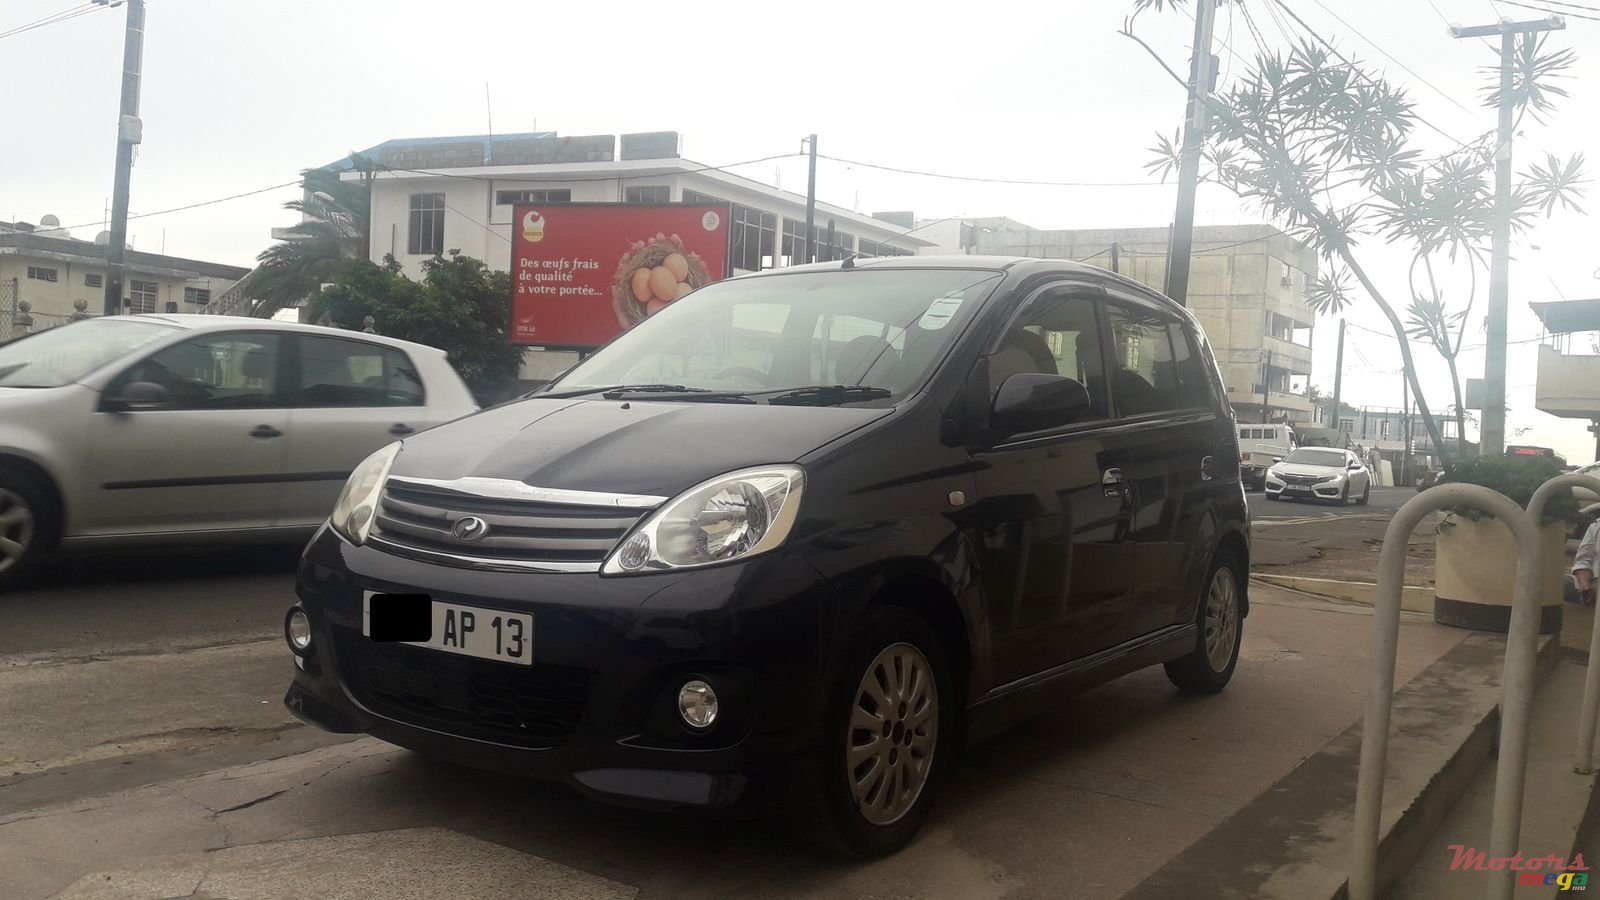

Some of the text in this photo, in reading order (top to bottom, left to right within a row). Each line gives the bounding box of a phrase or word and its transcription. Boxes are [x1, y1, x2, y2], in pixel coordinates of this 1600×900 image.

[520, 257, 599, 271] Des œufs frais
[519, 269, 573, 283] de qualité
[518, 283, 603, 297] à votre portée...
[443, 609, 523, 658] AP 13
